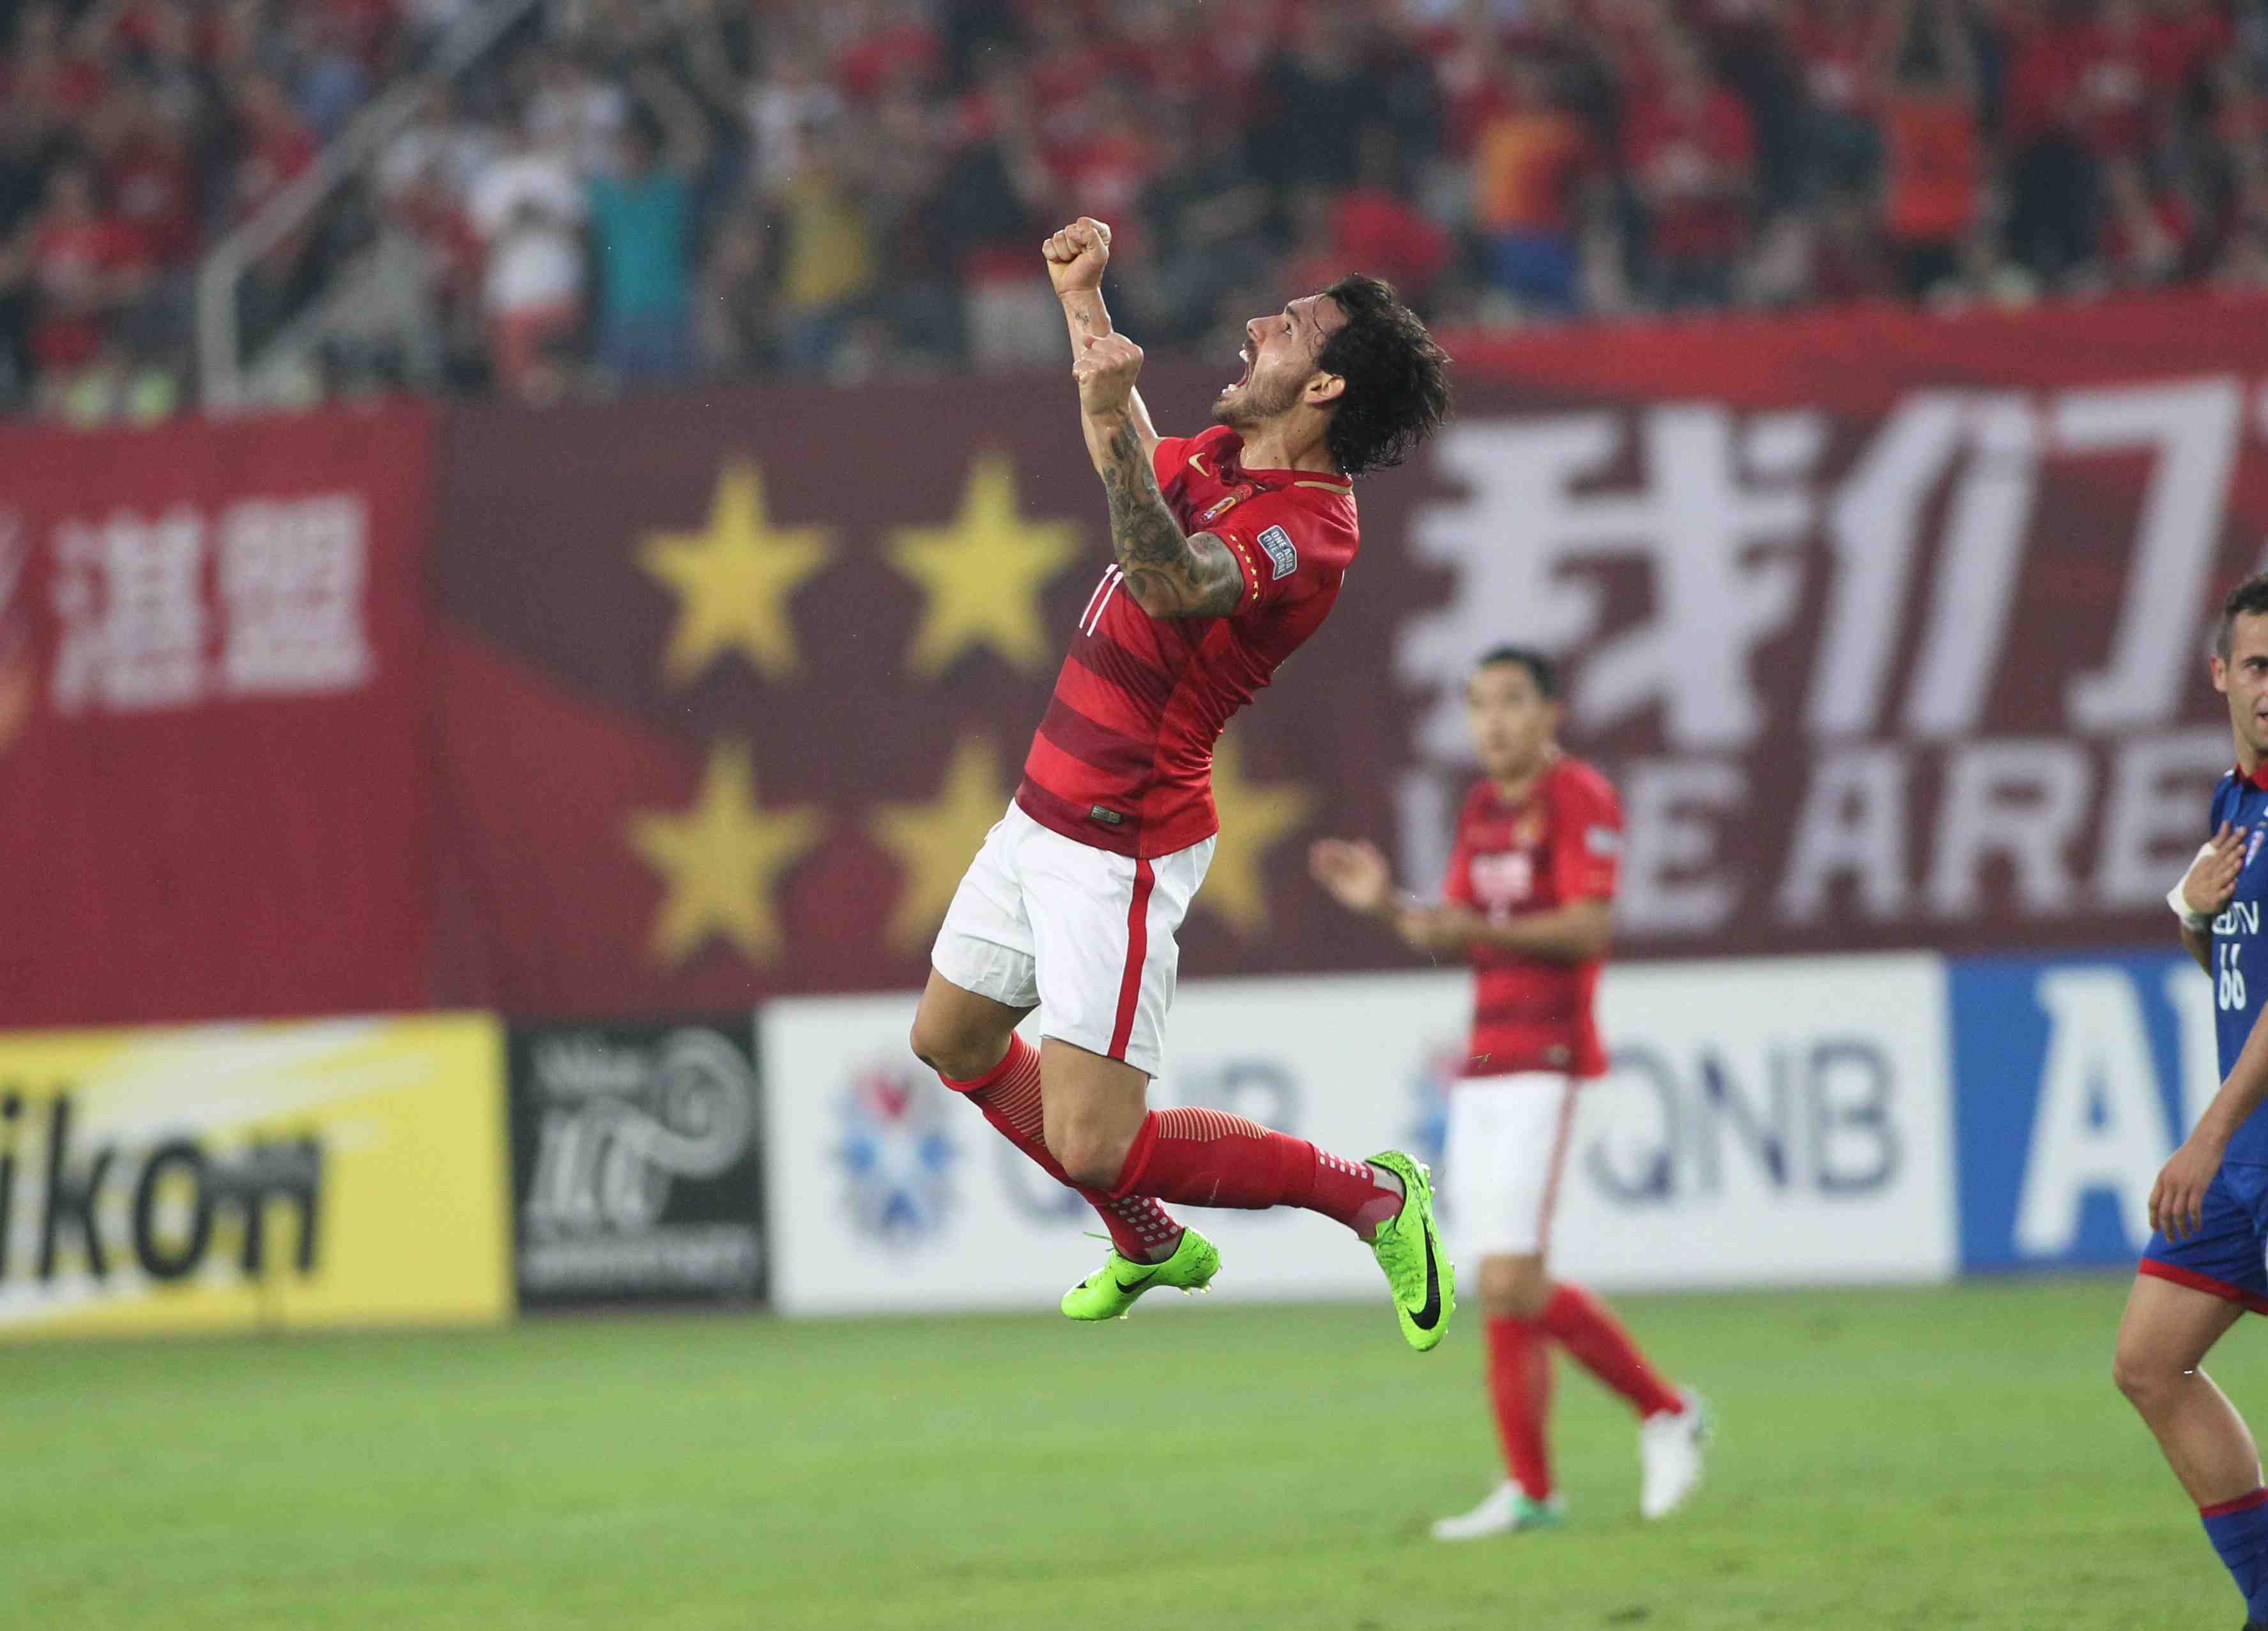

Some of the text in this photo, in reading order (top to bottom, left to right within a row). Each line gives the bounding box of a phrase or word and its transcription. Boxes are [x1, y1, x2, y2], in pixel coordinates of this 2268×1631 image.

[1079, 563, 1124, 637] 11
[1263, 535, 1278, 553] ONE
[1271, 531, 1293, 569] ONE ASIA
[1399, 376, 2236, 749] 我们
[1781, 731, 2236, 921] ARE
[1583, 1038, 1901, 1206] QNB
